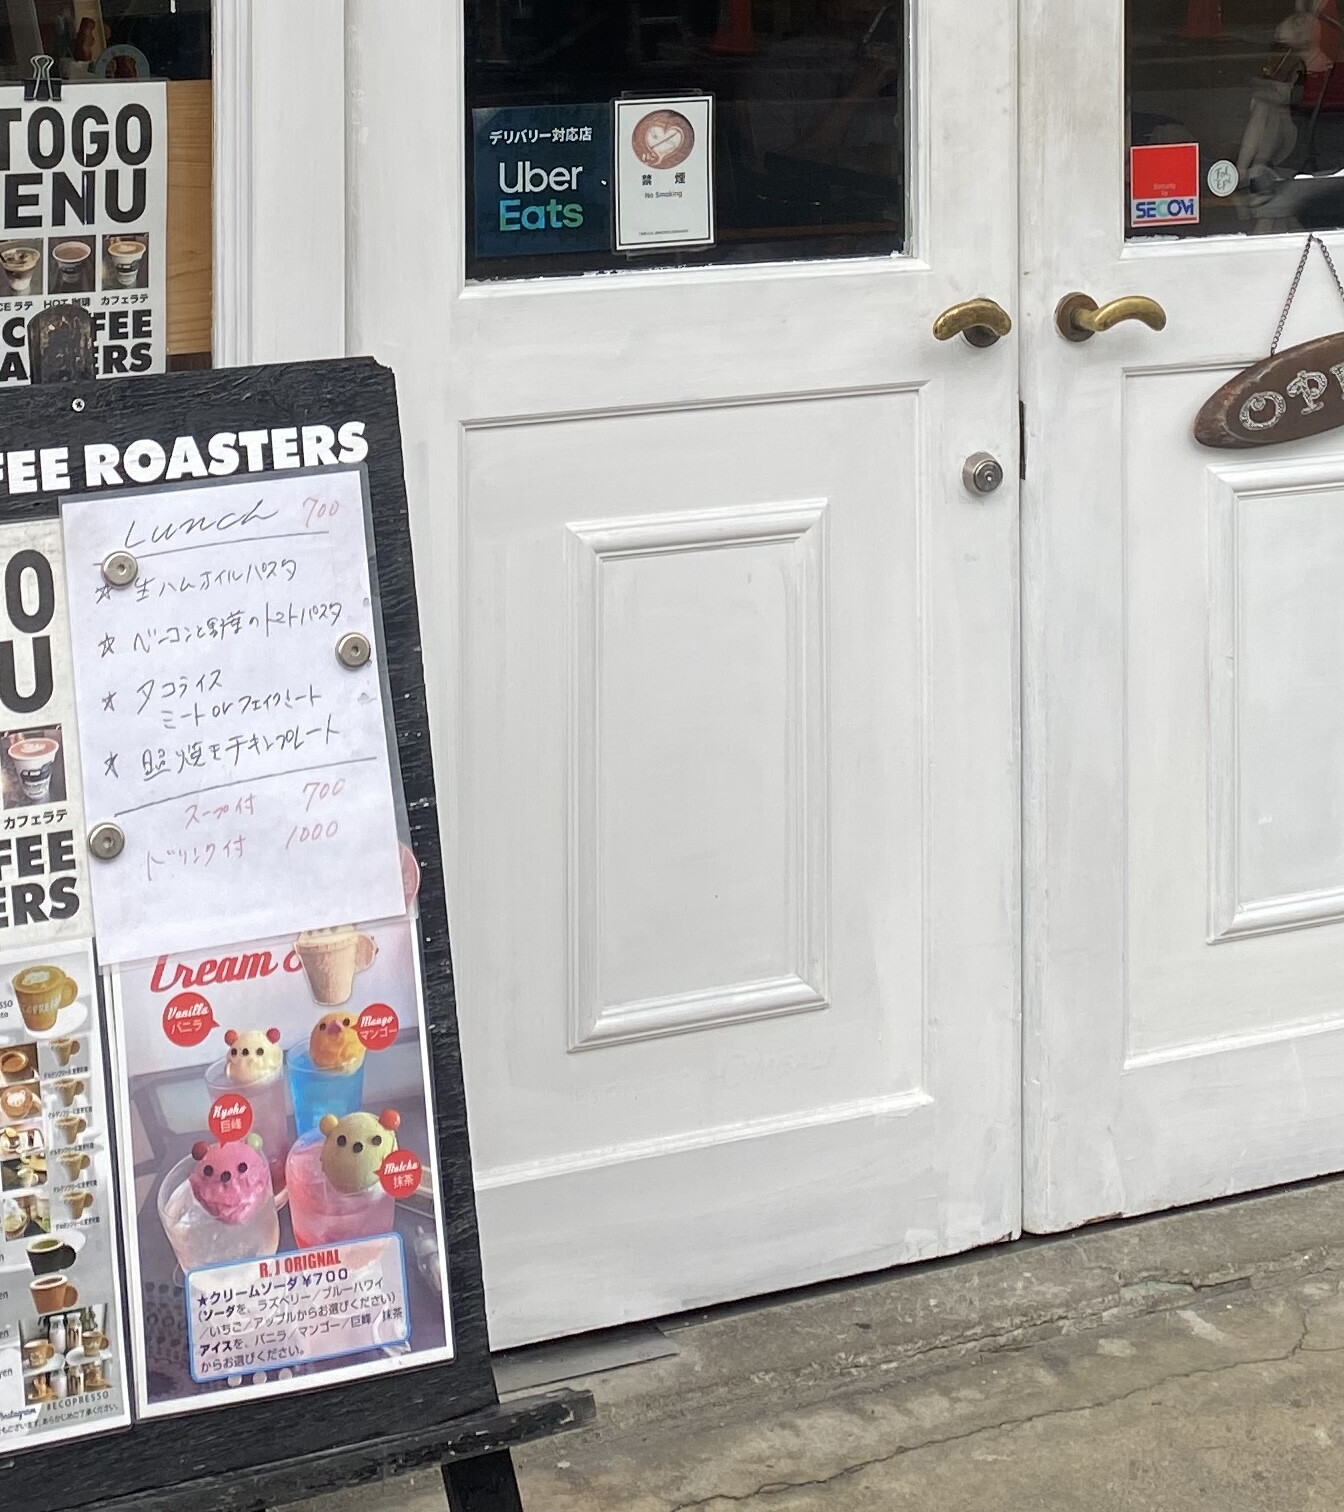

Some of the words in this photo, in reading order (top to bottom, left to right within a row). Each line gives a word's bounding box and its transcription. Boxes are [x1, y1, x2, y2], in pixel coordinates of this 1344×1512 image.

[489, 126, 593, 145] デリバリー対応店
[499, 160, 583, 194] Uber
[500, 198, 583, 231] Eats
[1135, 198, 1195, 218] SECOM
[13, 300, 34, 311] ラテ
[100, 293, 149, 306] カフェラテ
[83, 421, 368, 488] ROASTERS
[123, 499, 279, 549] Lunch
[302, 497, 340, 528] 700
[136, 670, 222, 715] タコライス
[303, 778, 346, 811] 700
[3, 809, 68, 831] カフェラテ
[285, 821, 339, 850] 1000
[168, 1004, 209, 1020] Vanilla
[171, 1019, 202, 1034] バニラ
[360, 1027, 397, 1041] マンゴー
